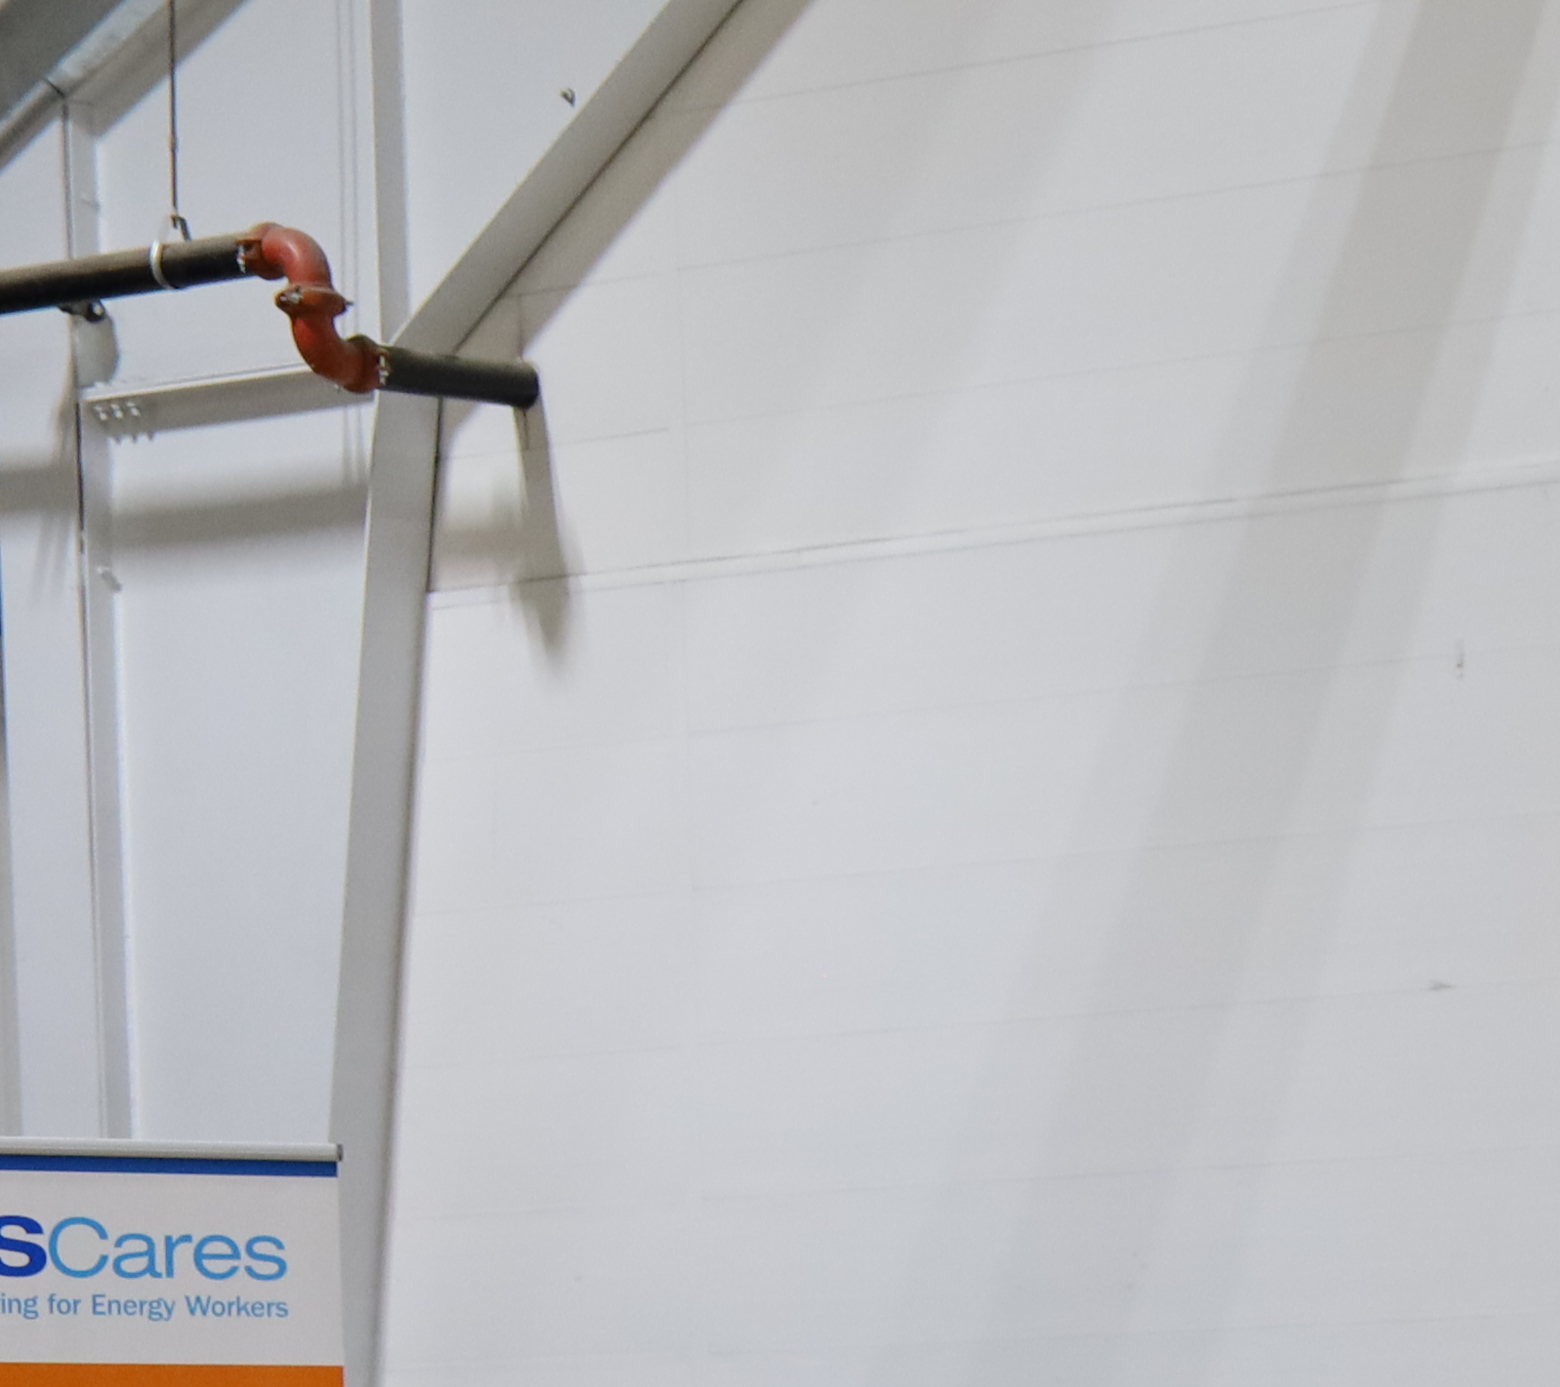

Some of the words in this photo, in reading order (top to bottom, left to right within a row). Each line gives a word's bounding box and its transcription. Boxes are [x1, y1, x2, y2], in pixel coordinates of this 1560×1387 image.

[47, 1293, 81, 1315] for
[92, 1294, 175, 1322] Energy
[184, 1295, 288, 1318] Workers
